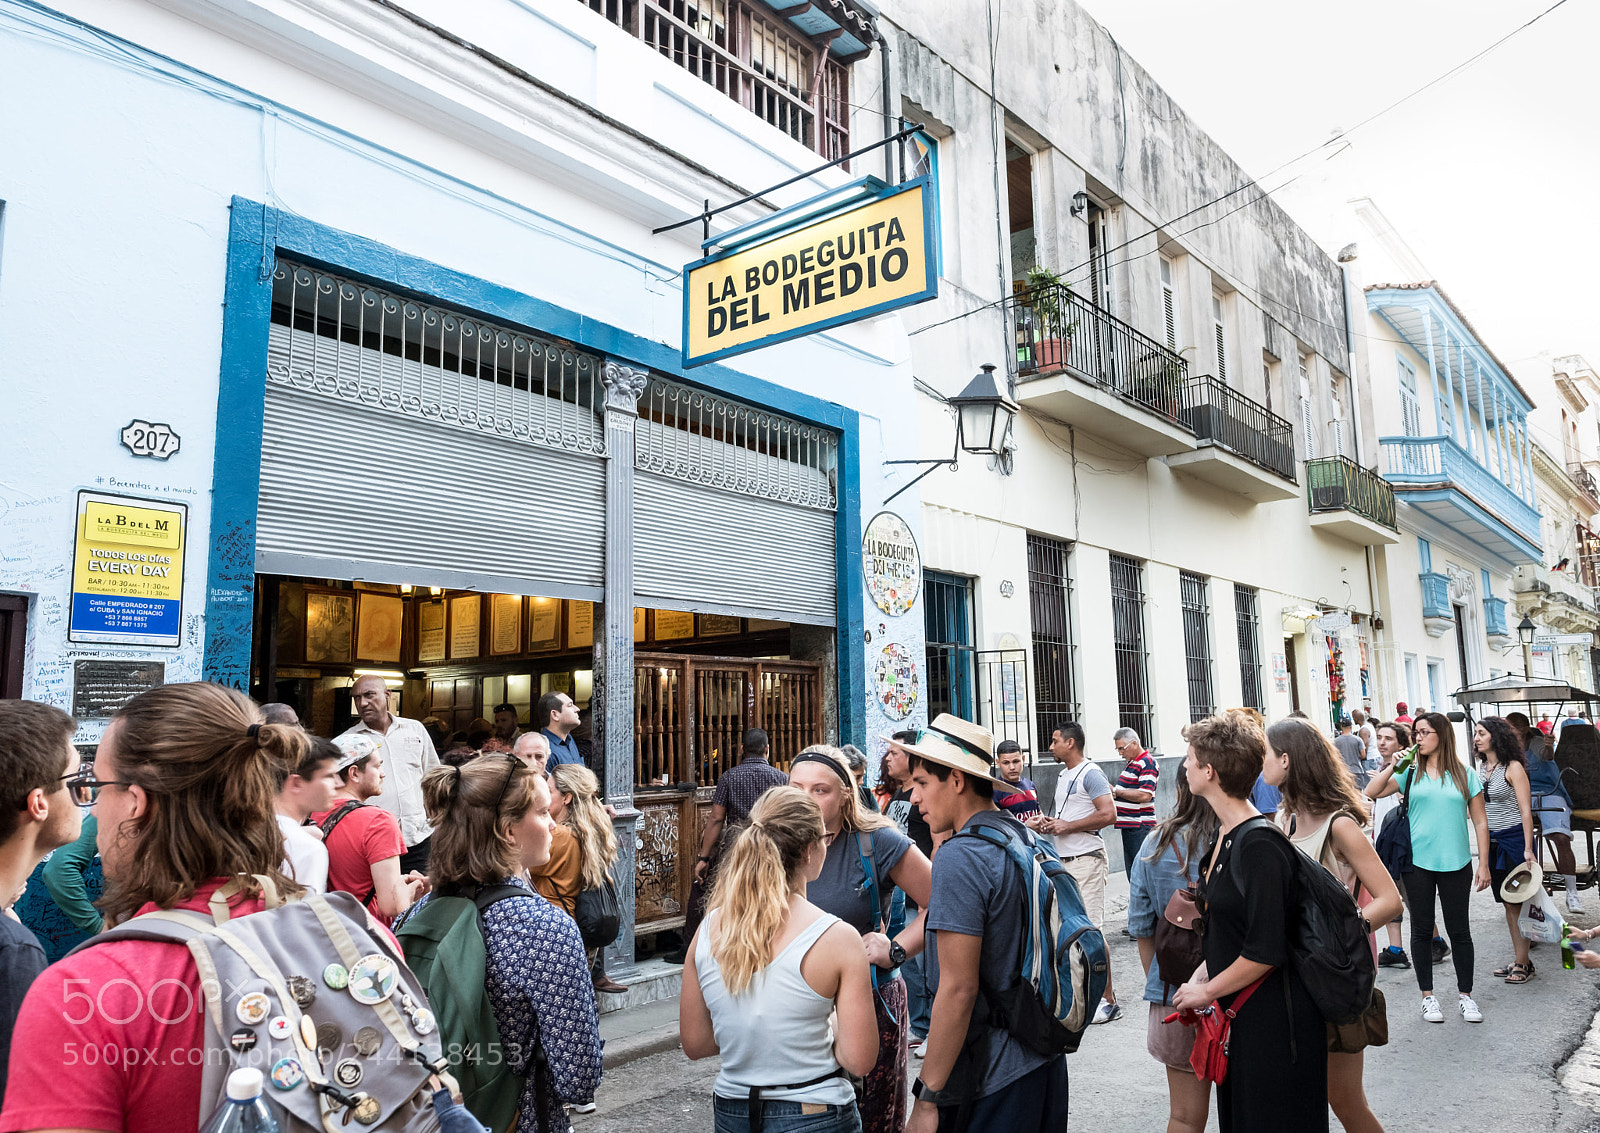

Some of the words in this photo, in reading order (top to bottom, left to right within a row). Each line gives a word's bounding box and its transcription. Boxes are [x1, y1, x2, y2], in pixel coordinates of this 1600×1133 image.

[707, 275, 737, 306] LA
[745, 216, 906, 294] BODEGUITA
[707, 294, 770, 338] DEL
[782, 247, 909, 316] MEDIO
[133, 428, 170, 452] 207
[130, 521, 151, 529] DEL
[90, 549, 125, 559] TODOS
[127, 554, 146, 562] LOS
[868, 539, 876, 555] LA
[878, 541, 914, 563] BODEGUITA
[89, 560, 138, 574] EVERY
[142, 565, 171, 578] DAY
[34, 692, 54, 700] LOVE
